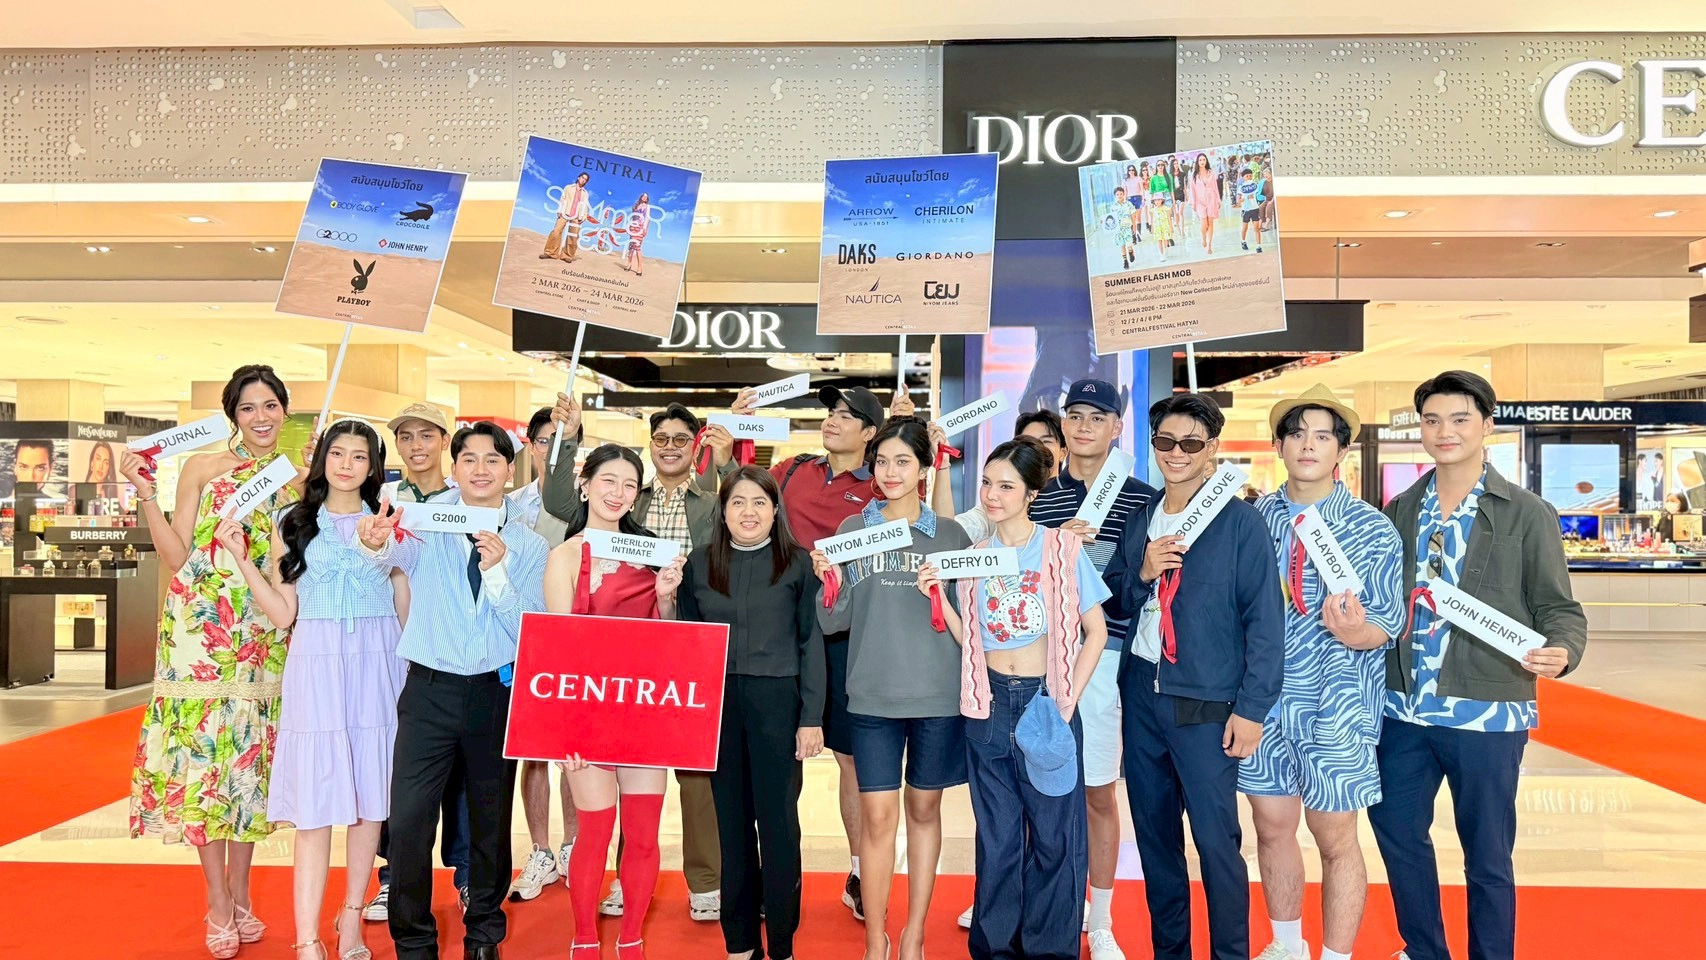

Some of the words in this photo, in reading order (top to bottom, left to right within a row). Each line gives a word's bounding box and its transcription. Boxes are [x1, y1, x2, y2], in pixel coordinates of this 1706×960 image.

[973, 114, 1139, 164] DIOR
[570, 154, 656, 184] CENTRAL
[864, 169, 949, 186] สนับสนุนโชว์โดย
[337, 201, 356, 210] BODY
[356, 204, 379, 213] GLOVE
[848, 208, 894, 216] ARROW
[914, 205, 974, 216] CHERILON
[396, 221, 430, 230] CROCODILE
[316, 228, 358, 243] G2000
[387, 241, 405, 250] JOHN
[405, 242, 428, 252] HENRY
[838, 243, 877, 265] DAKS
[896, 251, 974, 262] GIORDANO
[1104, 276, 1142, 288] SUMMER
[1143, 272, 1171, 282] FLASH
[1172, 269, 1192, 278] MOB
[531, 277, 537, 285] 2
[538, 278, 559, 289] MAR
[561, 283, 581, 294] 2026
[590, 289, 600, 298] 24
[602, 291, 623, 302] MAR
[624, 296, 645, 306] 2026
[1193, 286, 1222, 294] Collection
[336, 296, 372, 306] PLAYBOY
[845, 294, 903, 304] NAUTICA
[658, 310, 786, 348] DIOR
[1122, 324, 1176, 335] CENTRALFESTIVAL
[758, 382, 795, 400] NAUTICA
[945, 399, 999, 429] GIORDANO
[1572, 407, 1632, 420] LAUDER
[738, 423, 765, 432] DAKS
[153, 425, 212, 450] JOURNAL
[235, 477, 272, 507] LOLITA
[1093, 472, 1117, 510] ARROW
[1176, 508, 1205, 538] BODY
[1203, 471, 1235, 509] GLOVE
[432, 513, 467, 524] G2000
[70, 530, 128, 540] BURBERRY
[611, 536, 656, 549] CHERILON
[825, 538, 863, 556] NIYOM
[865, 527, 904, 545] JEANS
[611, 545, 652, 558] INTIMATE
[1310, 528, 1348, 580] PLAYBOY
[941, 556, 982, 569] DEFRY
[985, 555, 999, 567] 01
[1442, 595, 1480, 621] JOHN
[1479, 615, 1528, 647] HENRY
[529, 671, 706, 708] CENTRAL
